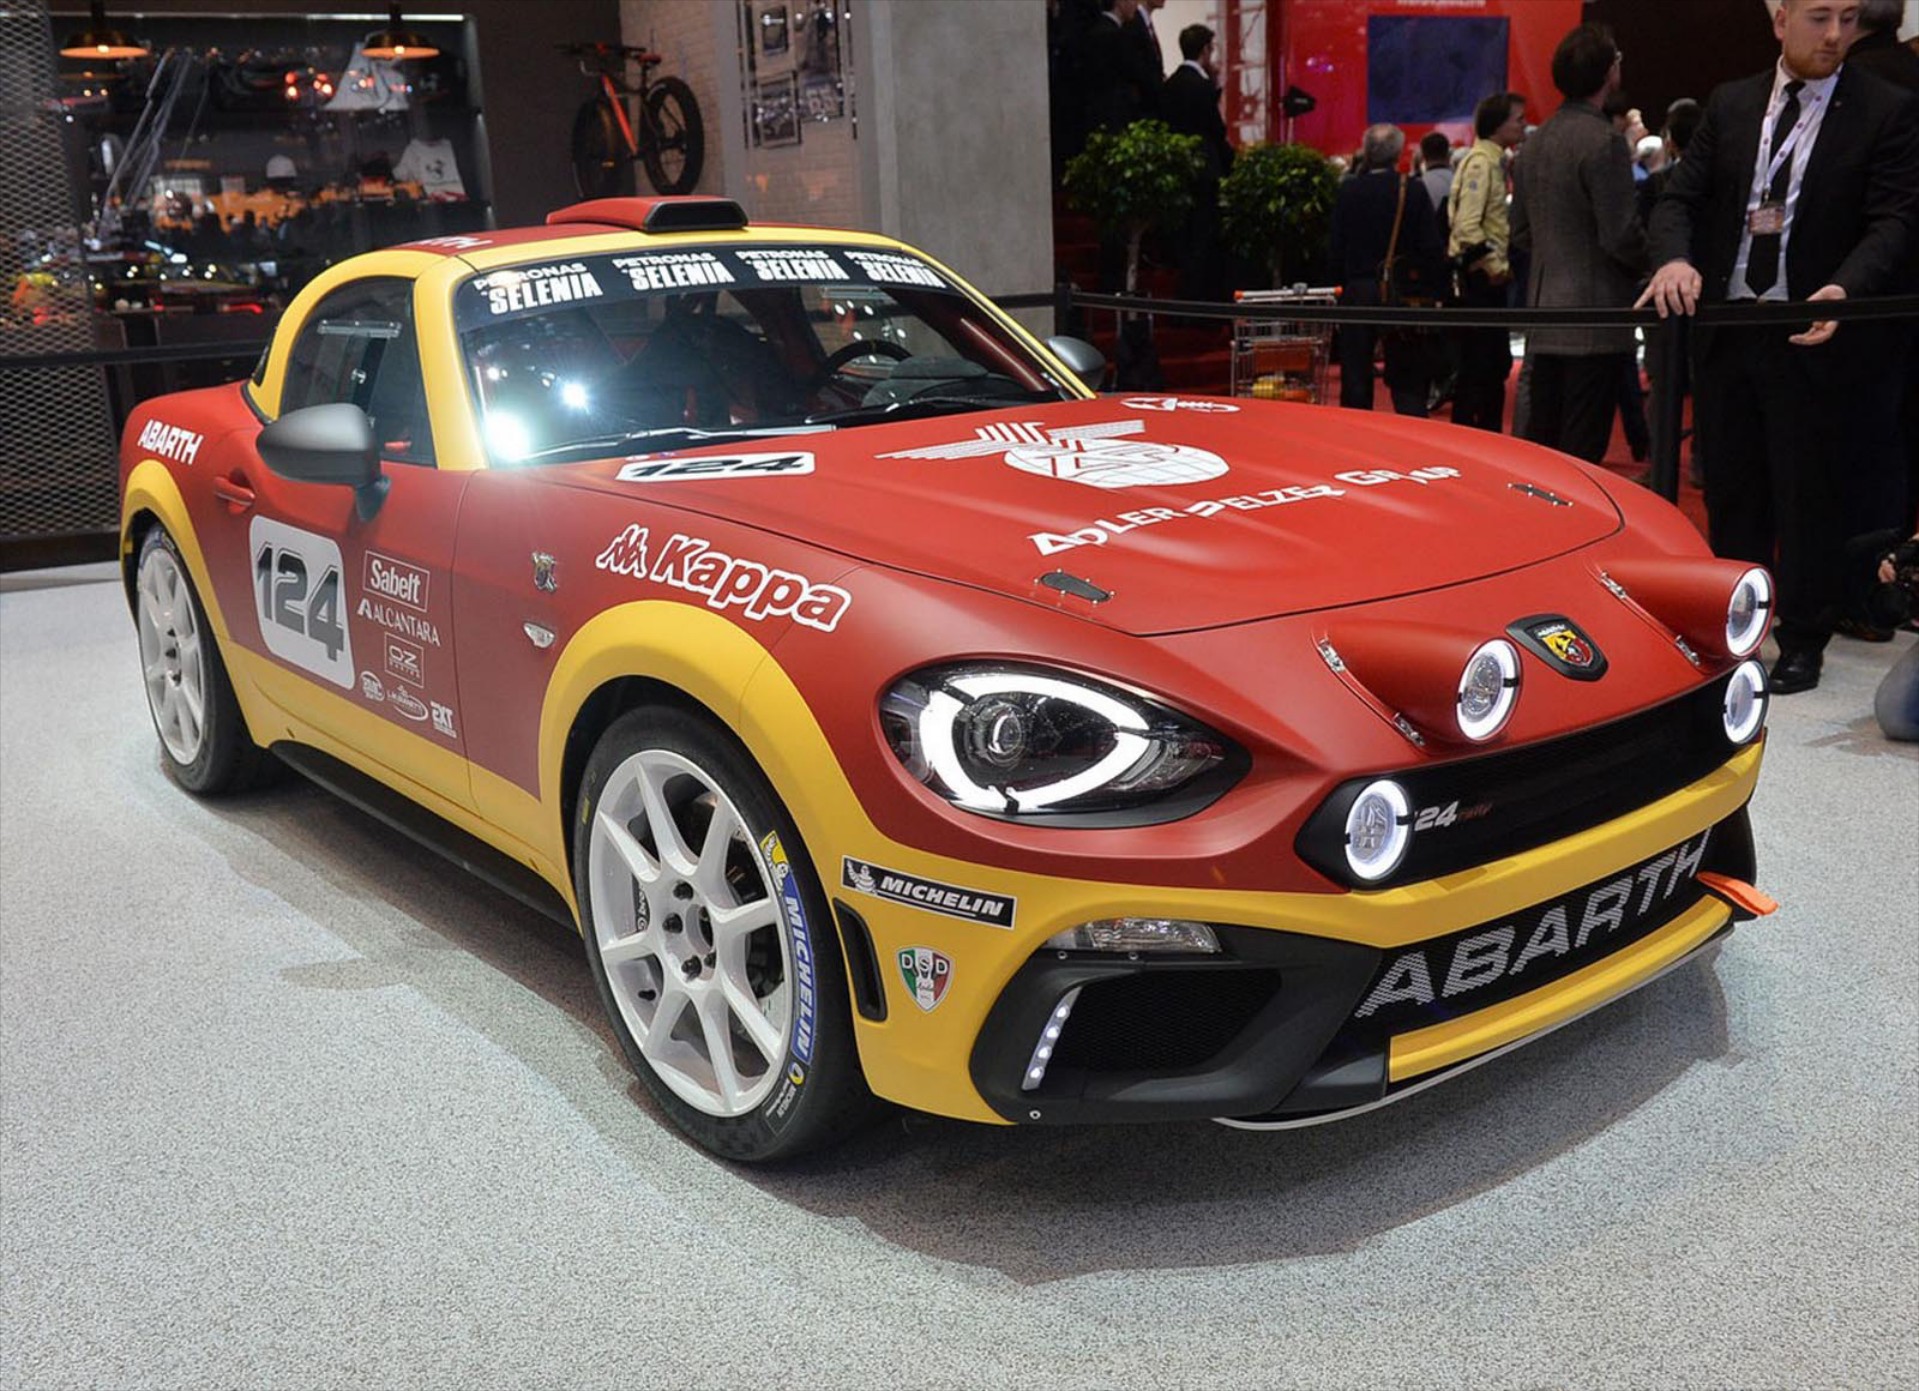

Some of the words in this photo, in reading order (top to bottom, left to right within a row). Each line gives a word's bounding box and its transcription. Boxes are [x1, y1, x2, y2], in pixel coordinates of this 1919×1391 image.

[612, 252, 717, 269] PETRONAS
[735, 251, 830, 260] PETRONAS
[753, 259, 850, 280] SELENIA
[844, 251, 924, 267] PETRONAS
[473, 263, 587, 290] PRONAS
[629, 261, 736, 290] SELENIA
[860, 261, 947, 288] SELENIA
[489, 272, 603, 315] SELENIA
[137, 419, 204, 465] ABARTH
[630, 456, 804, 477] 124
[1026, 506, 1188, 556] ADLER
[370, 559, 421, 603] Sabelt
[650, 533, 852, 633] Kappa
[257, 541, 344, 662] 124
[1413, 801, 1459, 831] 24
[880, 875, 1005, 917] MICHELIN
[1355, 824, 1714, 1018] ABARTH
[785, 896, 813, 1057] MICHELIN
